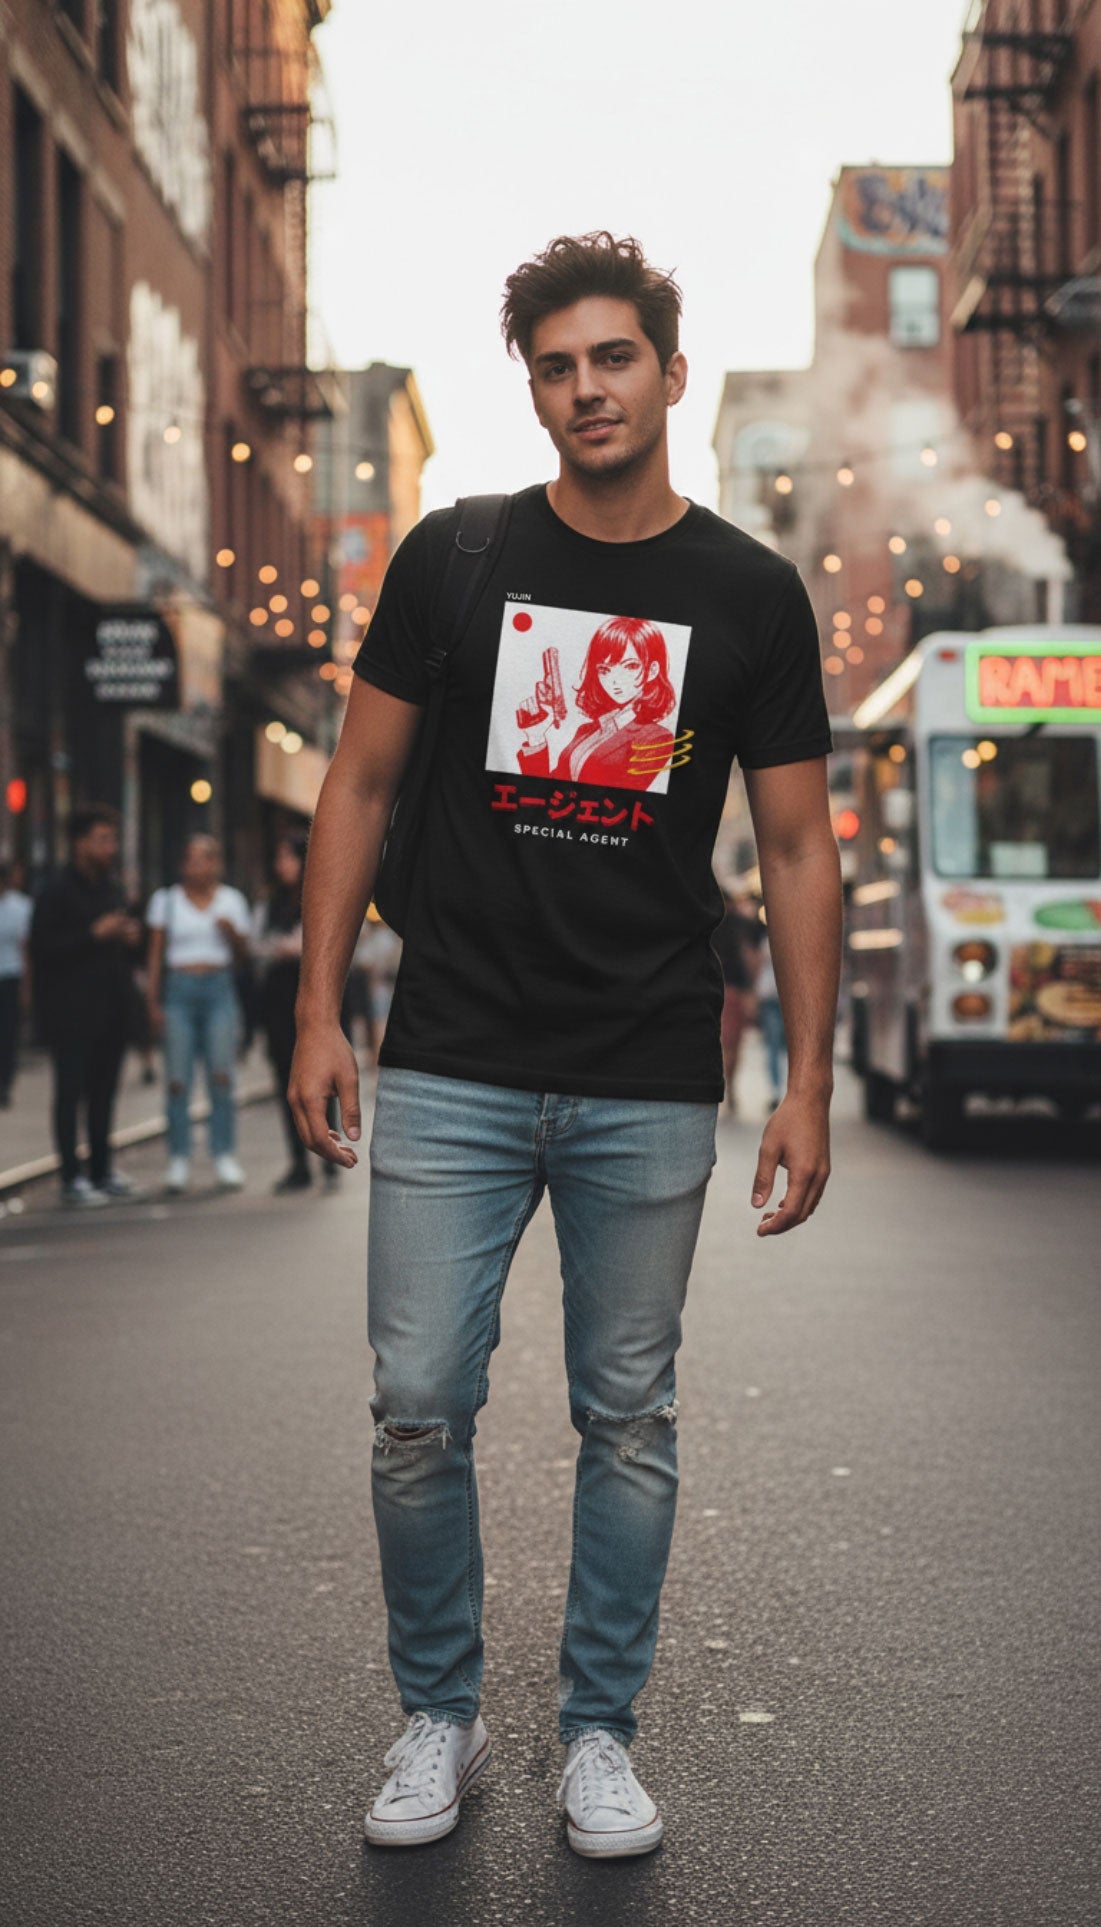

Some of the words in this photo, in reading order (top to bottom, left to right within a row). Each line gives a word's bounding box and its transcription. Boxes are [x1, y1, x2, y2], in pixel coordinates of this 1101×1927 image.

[506, 592, 532, 601] YUJIN
[491, 784, 654, 831] エージェント
[514, 824, 573, 840] SPECIAL
[579, 833, 630, 847] AGENT
